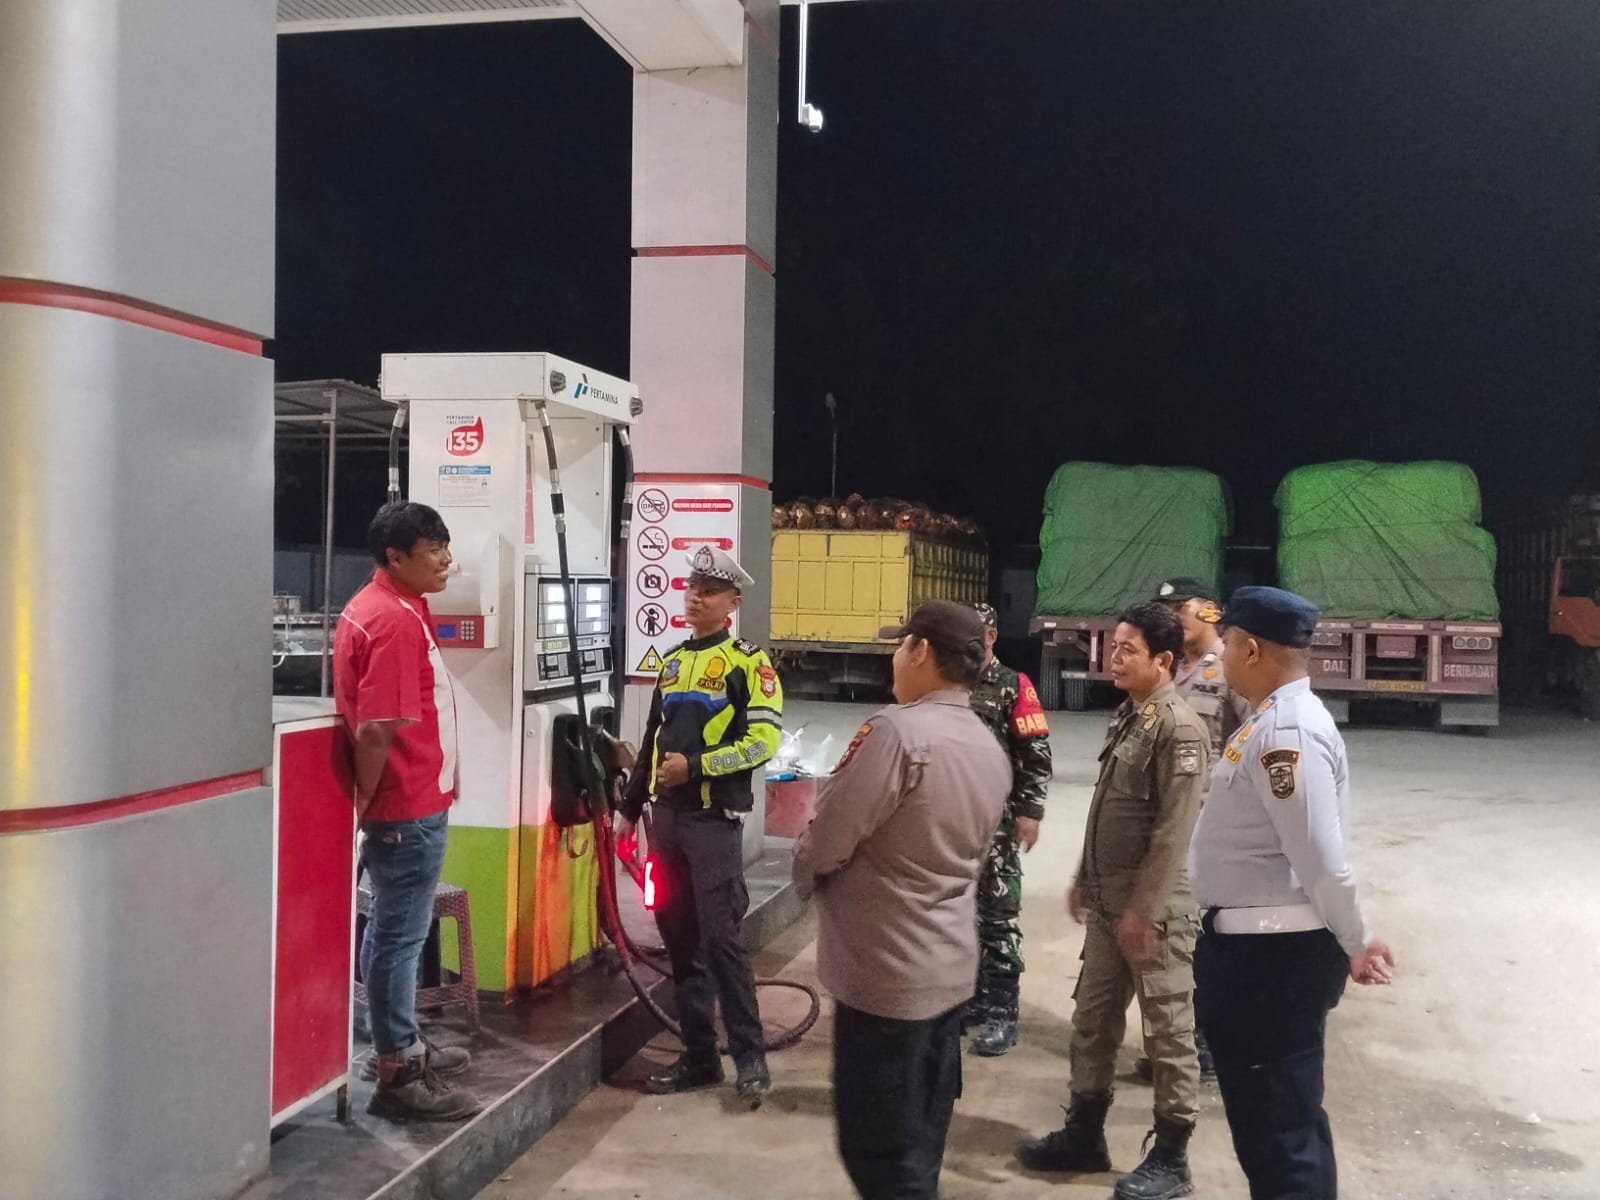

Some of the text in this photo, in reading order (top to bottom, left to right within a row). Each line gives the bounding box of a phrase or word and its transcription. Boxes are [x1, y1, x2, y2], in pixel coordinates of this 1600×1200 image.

[590, 386, 618, 405] PERTAMINA
[699, 680, 723, 689] POLRI
[710, 740, 767, 771] POLISI
